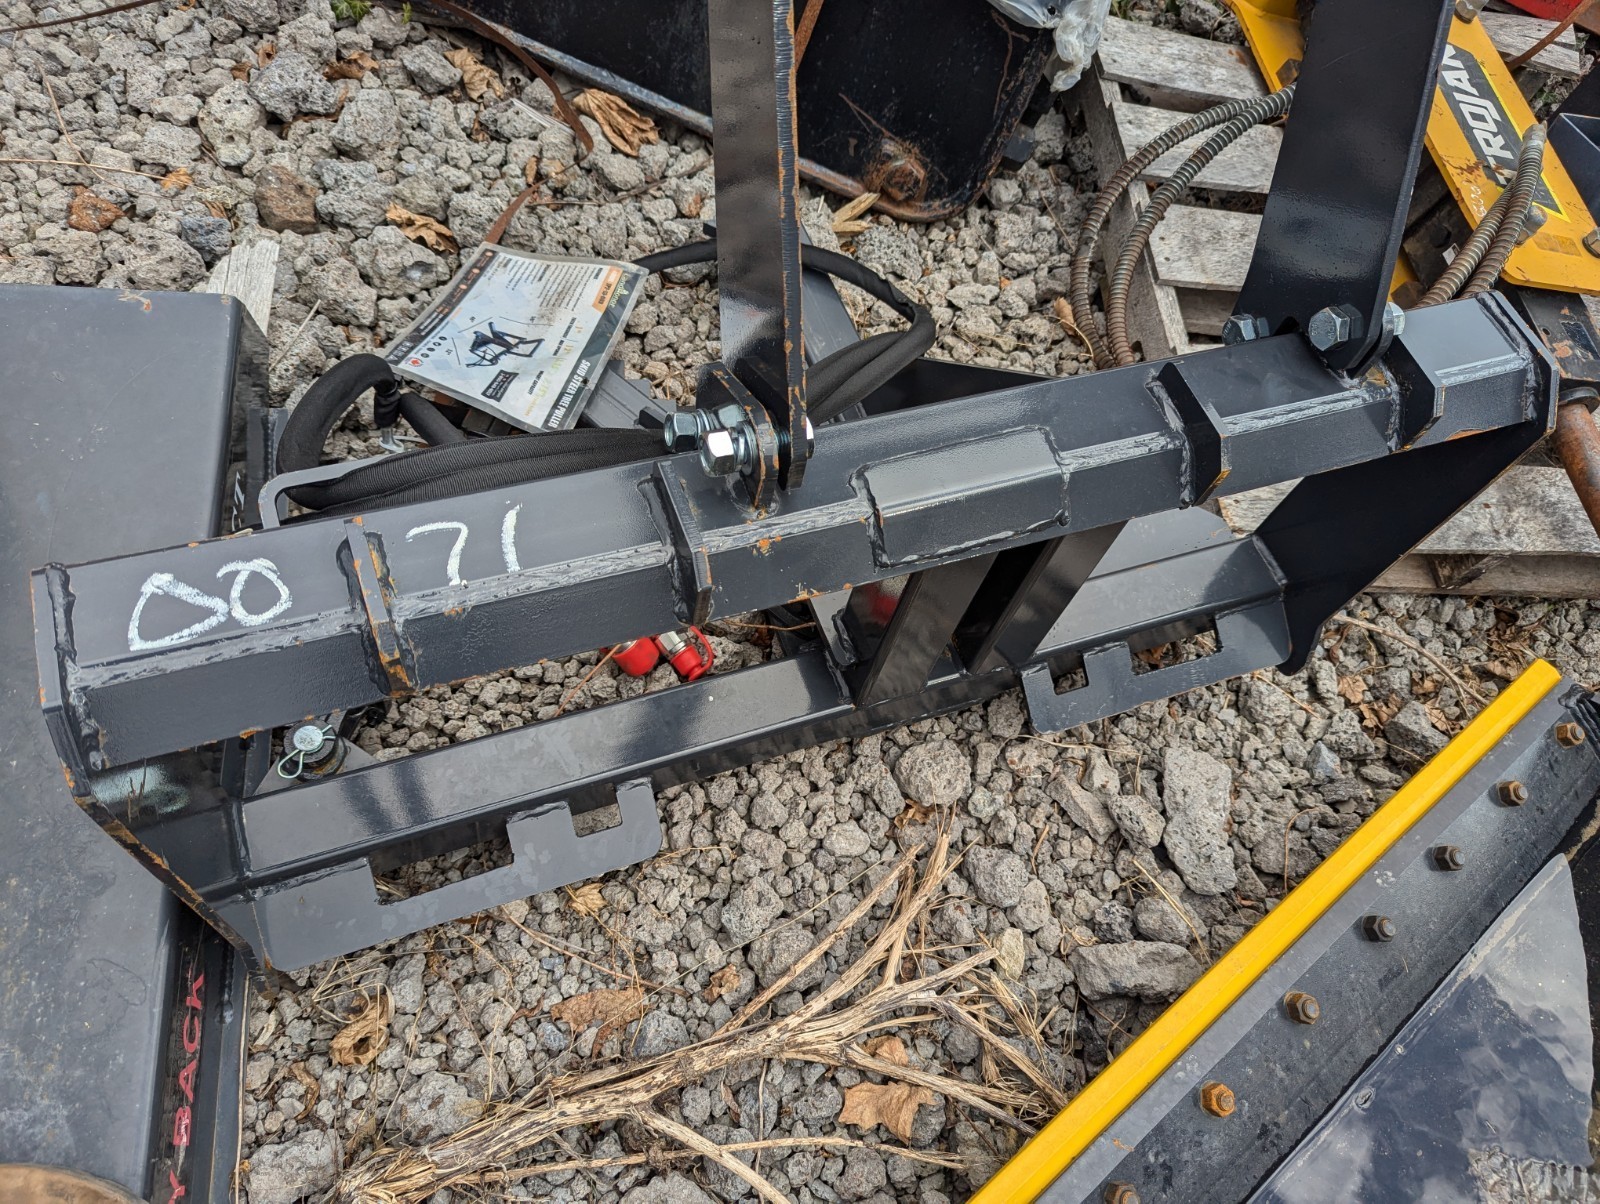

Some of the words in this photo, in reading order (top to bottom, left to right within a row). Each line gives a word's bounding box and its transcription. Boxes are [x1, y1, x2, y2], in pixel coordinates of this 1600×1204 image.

[1442, 43, 1518, 188] TROJAN
[574, 359, 591, 375] SKID
[565, 374, 583, 394] STEER
[558, 392, 573, 407] TREE
[547, 405, 566, 428] PULLER
